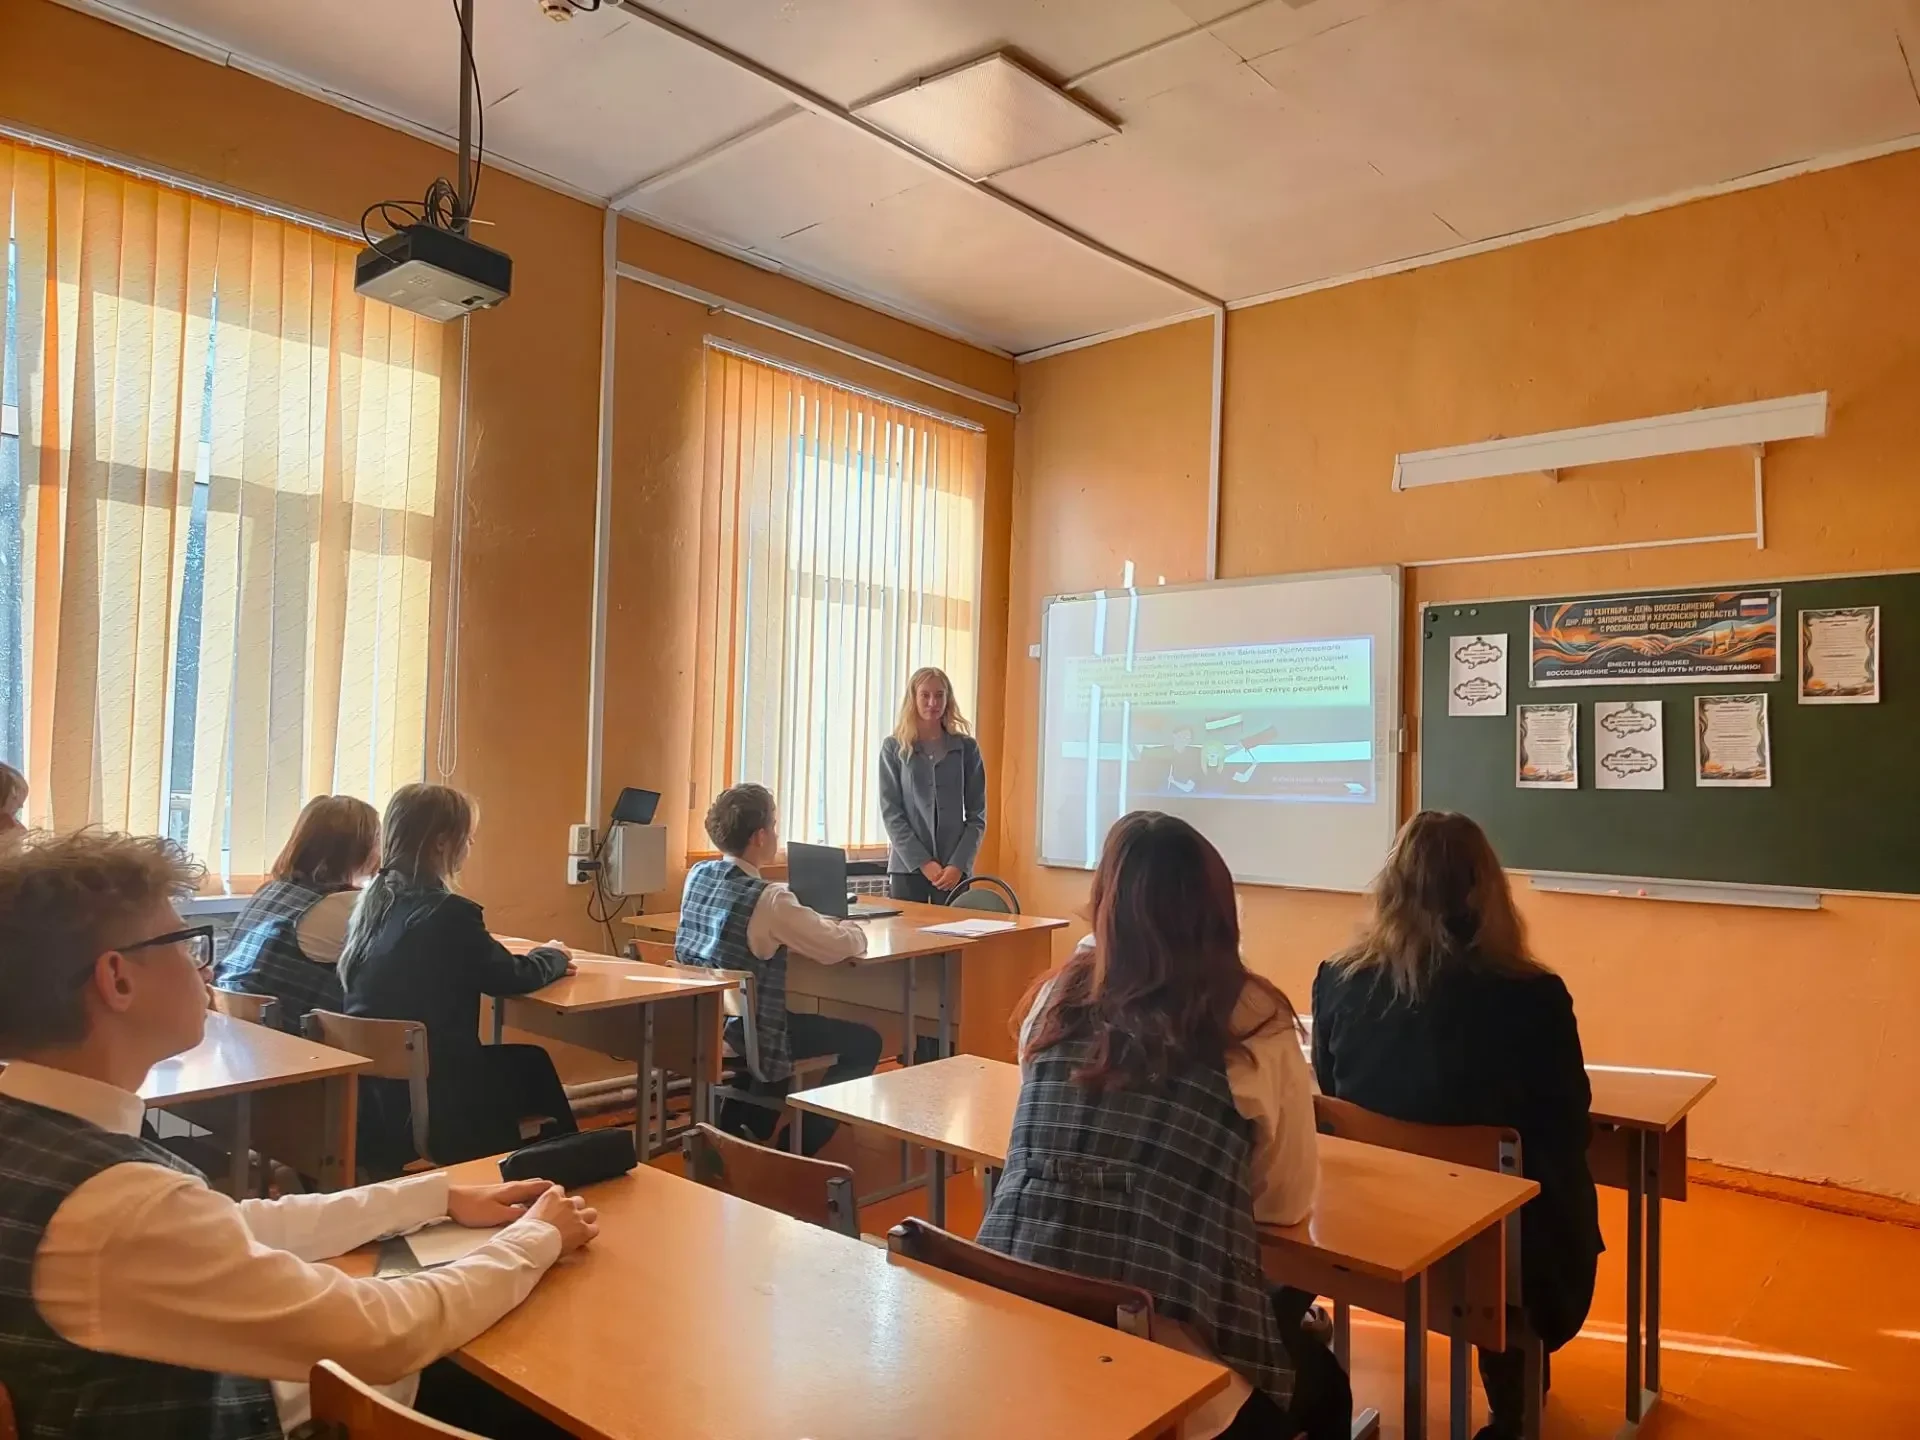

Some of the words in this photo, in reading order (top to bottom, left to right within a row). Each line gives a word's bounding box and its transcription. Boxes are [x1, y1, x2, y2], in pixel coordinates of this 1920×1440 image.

[1594, 606, 1628, 615] СЕНТЯБРЯ
[1634, 604, 1652, 614] ДЕНЬ
[1654, 602, 1715, 612] ВОССОЕДИНЕНИЯ
[1598, 614, 1646, 624] ЗАПОРОЖСКОЙ
[1654, 610, 1699, 621] ХЕРСОНСКОЙ
[1700, 608, 1737, 619] ОБЛАСТЕЙ
[1606, 622, 1648, 632] РОССИЙСКОЙ
[1650, 621, 1697, 631] ФЕДЕРАЦИЕЙ
[1696, 664, 1761, 672] ПРОЦВЕТАНИЮ!
